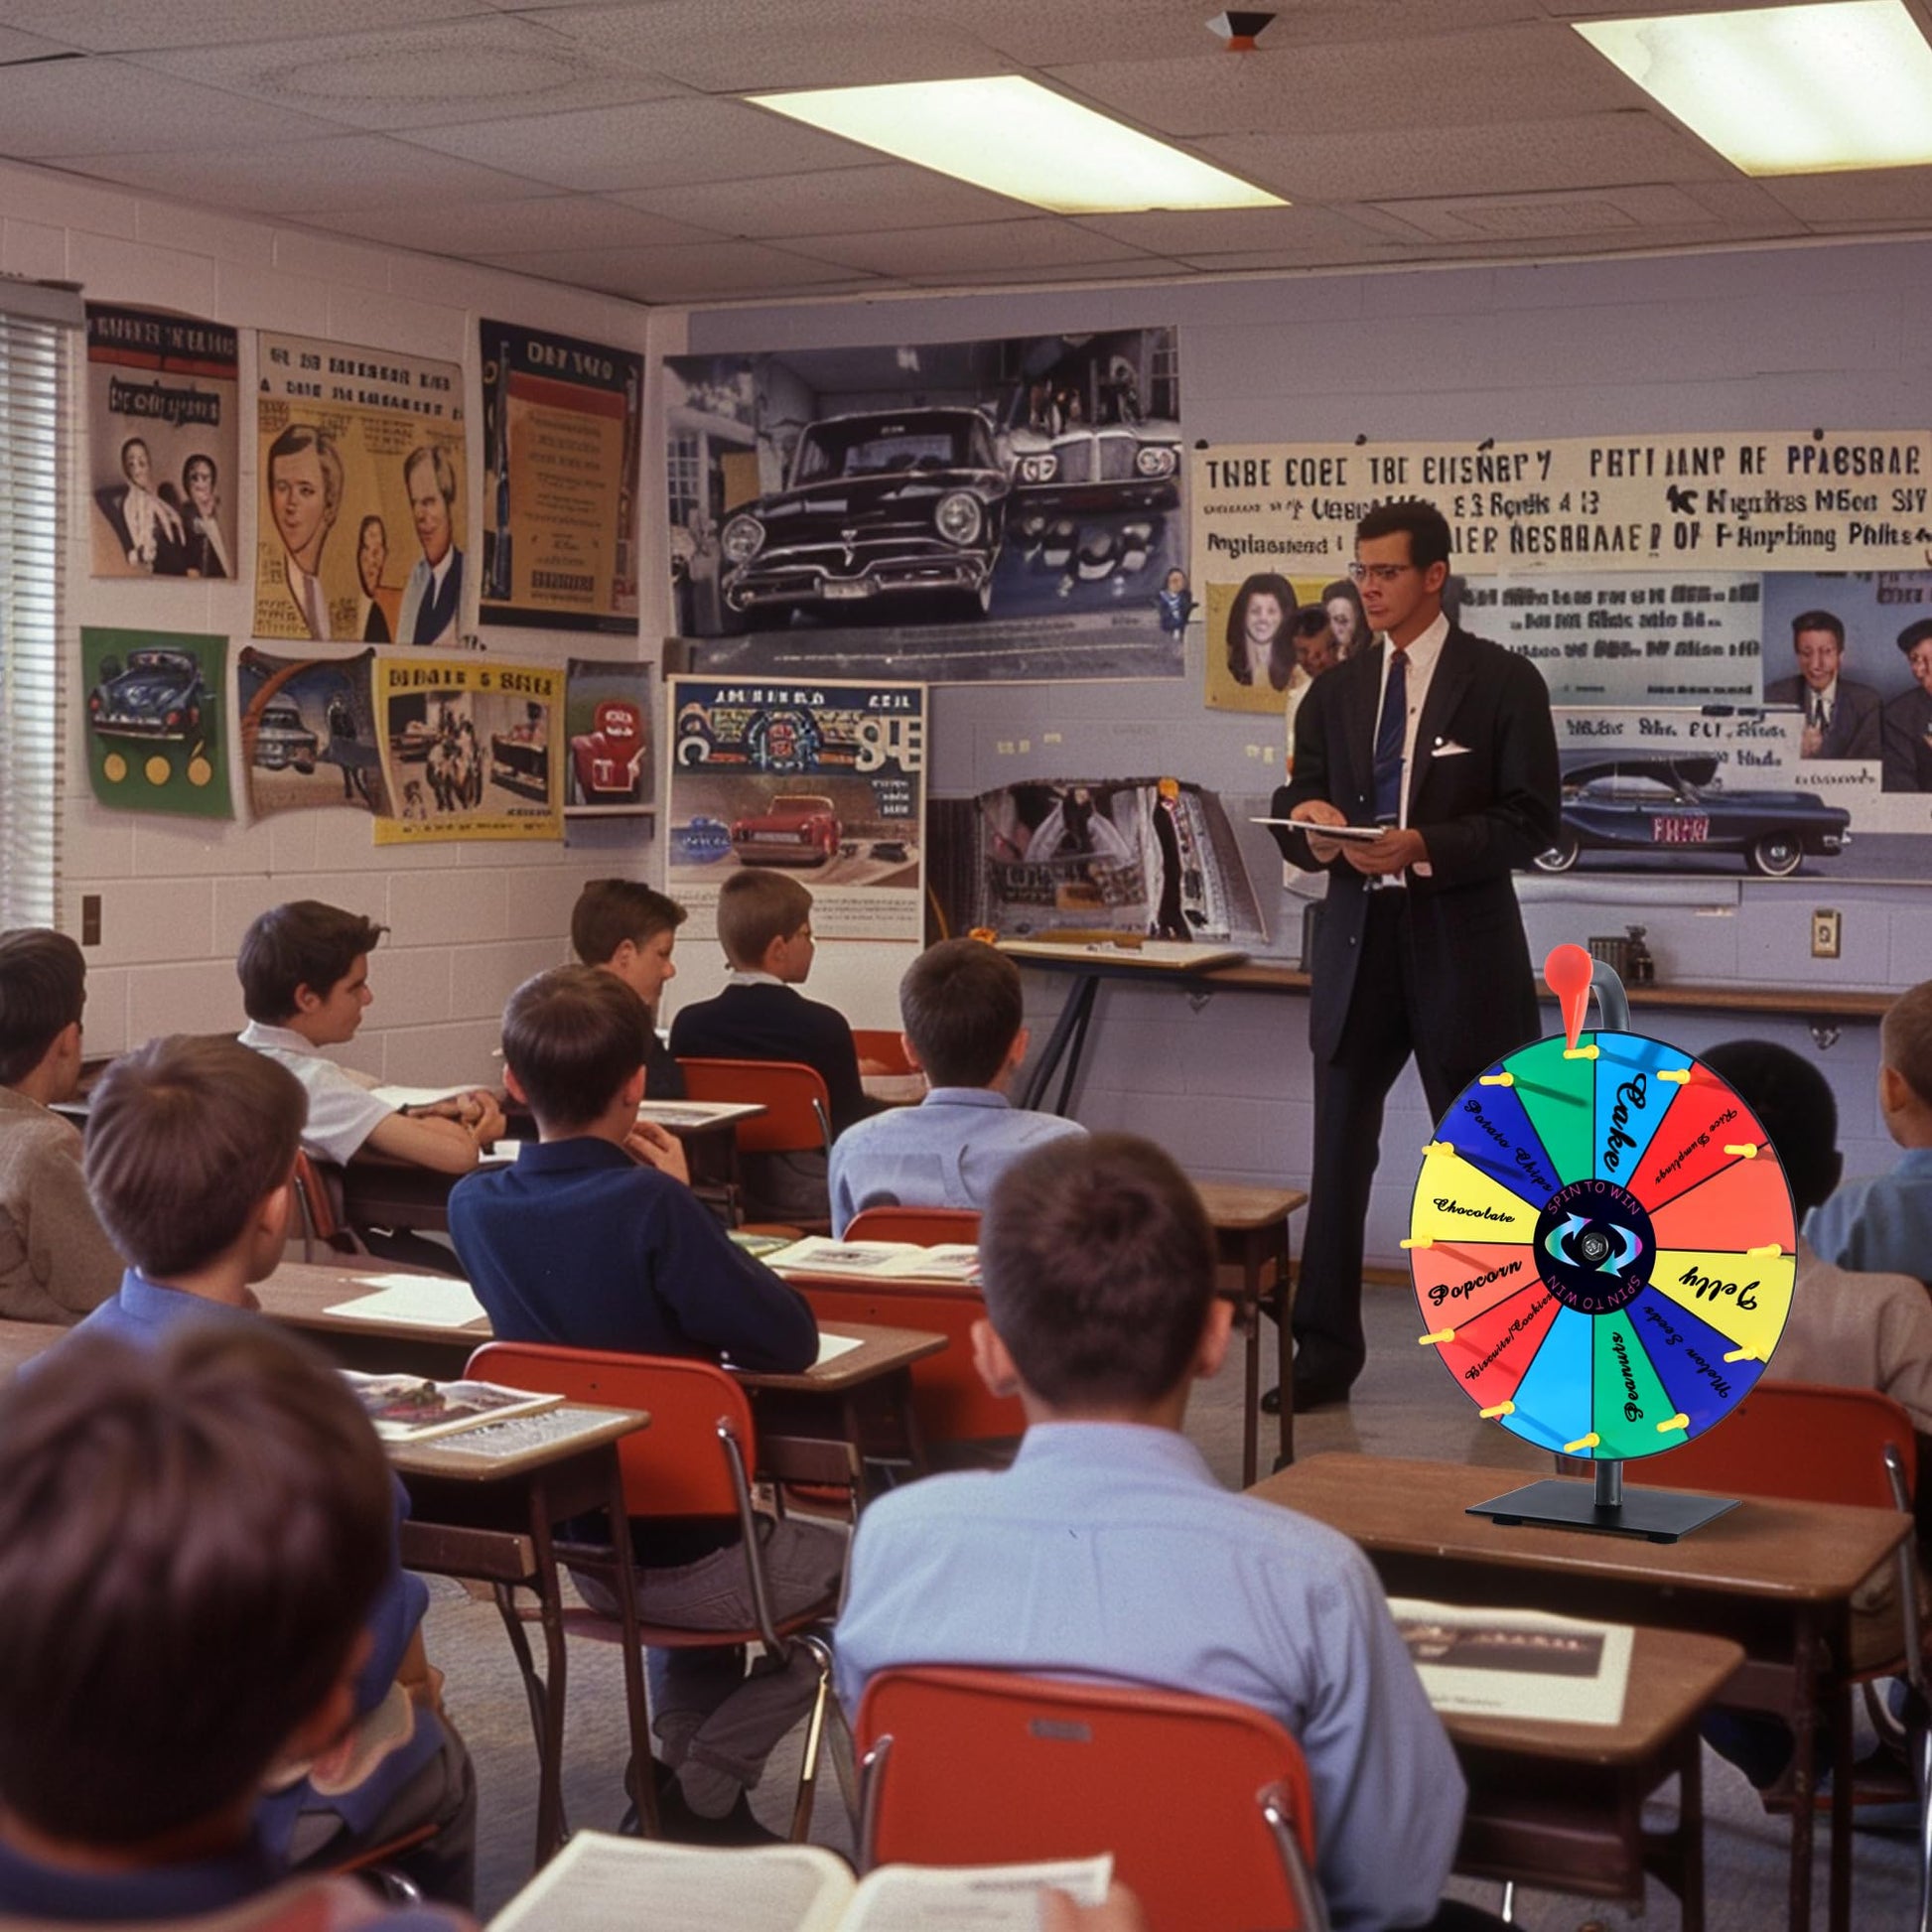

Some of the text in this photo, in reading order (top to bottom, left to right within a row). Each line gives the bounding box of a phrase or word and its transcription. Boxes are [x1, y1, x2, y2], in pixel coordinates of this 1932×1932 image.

[1463, 1099, 1555, 1191] Potato Chips
[1603, 1073, 1646, 1173] Cake
[1655, 1108, 1737, 1184] Rice Dumplings
[1433, 1197, 1516, 1223] Chocolate
[1548, 1180, 1641, 1216] SPIN TO WIN
[1428, 1260, 1523, 1307] Popcorn
[1547, 1275, 1641, 1311] SPIN TO WIN
[1678, 1266, 1761, 1311] Jelly
[1612, 1331, 1644, 1423] Peanuts
[1643, 1306, 1732, 1399] Melon Seeds
